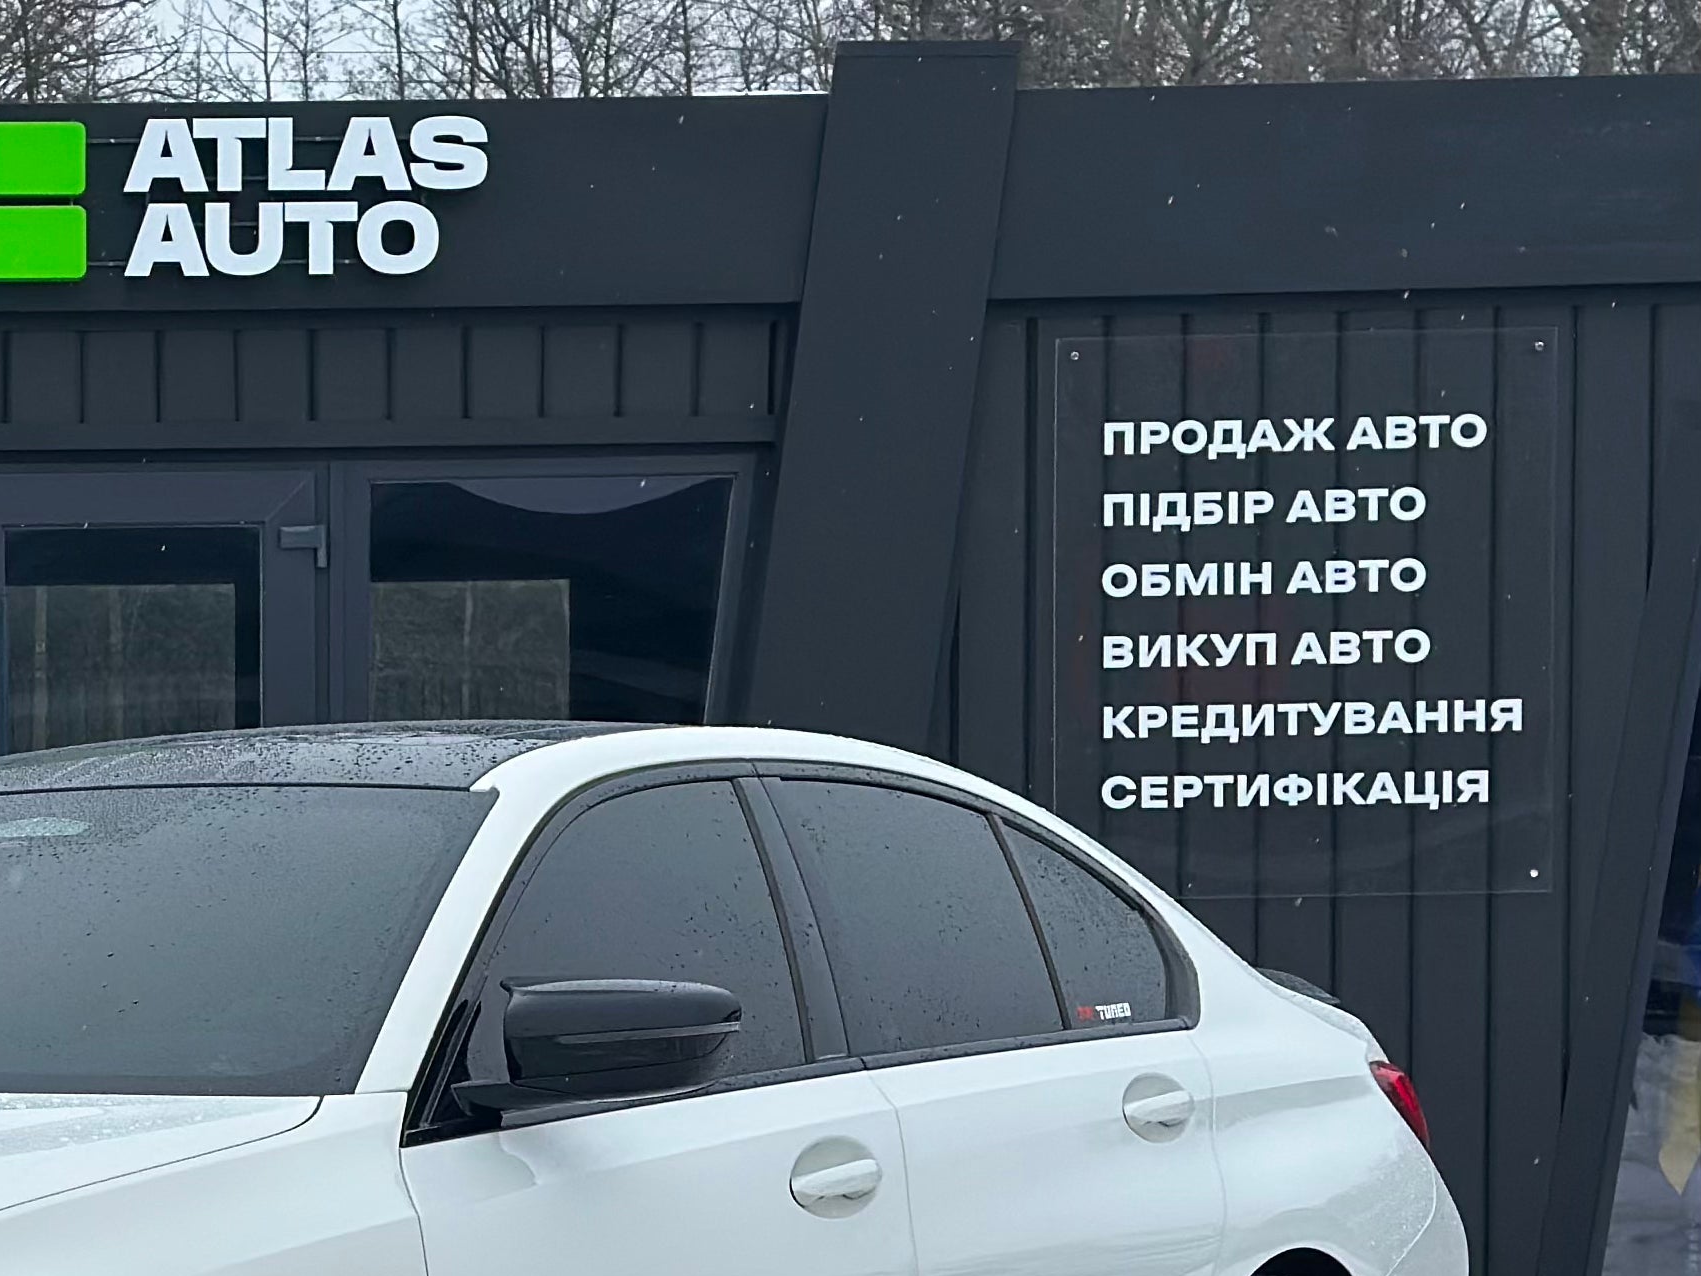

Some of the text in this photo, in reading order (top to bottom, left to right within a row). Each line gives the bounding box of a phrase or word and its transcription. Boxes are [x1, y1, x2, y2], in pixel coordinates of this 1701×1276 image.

[124, 115, 489, 193] ATLAS
[124, 200, 440, 277] AUTO
[1103, 413, 1488, 460] ПРОДАЖ АВТО
[1103, 486, 1427, 532] ПІДБІР АВТО
[1102, 557, 1427, 598] ОБМІН АВТО
[1103, 628, 1431, 669] ВИКУП АВТО
[1103, 698, 1523, 743] КРЕДИТУВАННЯ
[1102, 769, 1489, 811] СЕРТИФІКАЦІЯ
